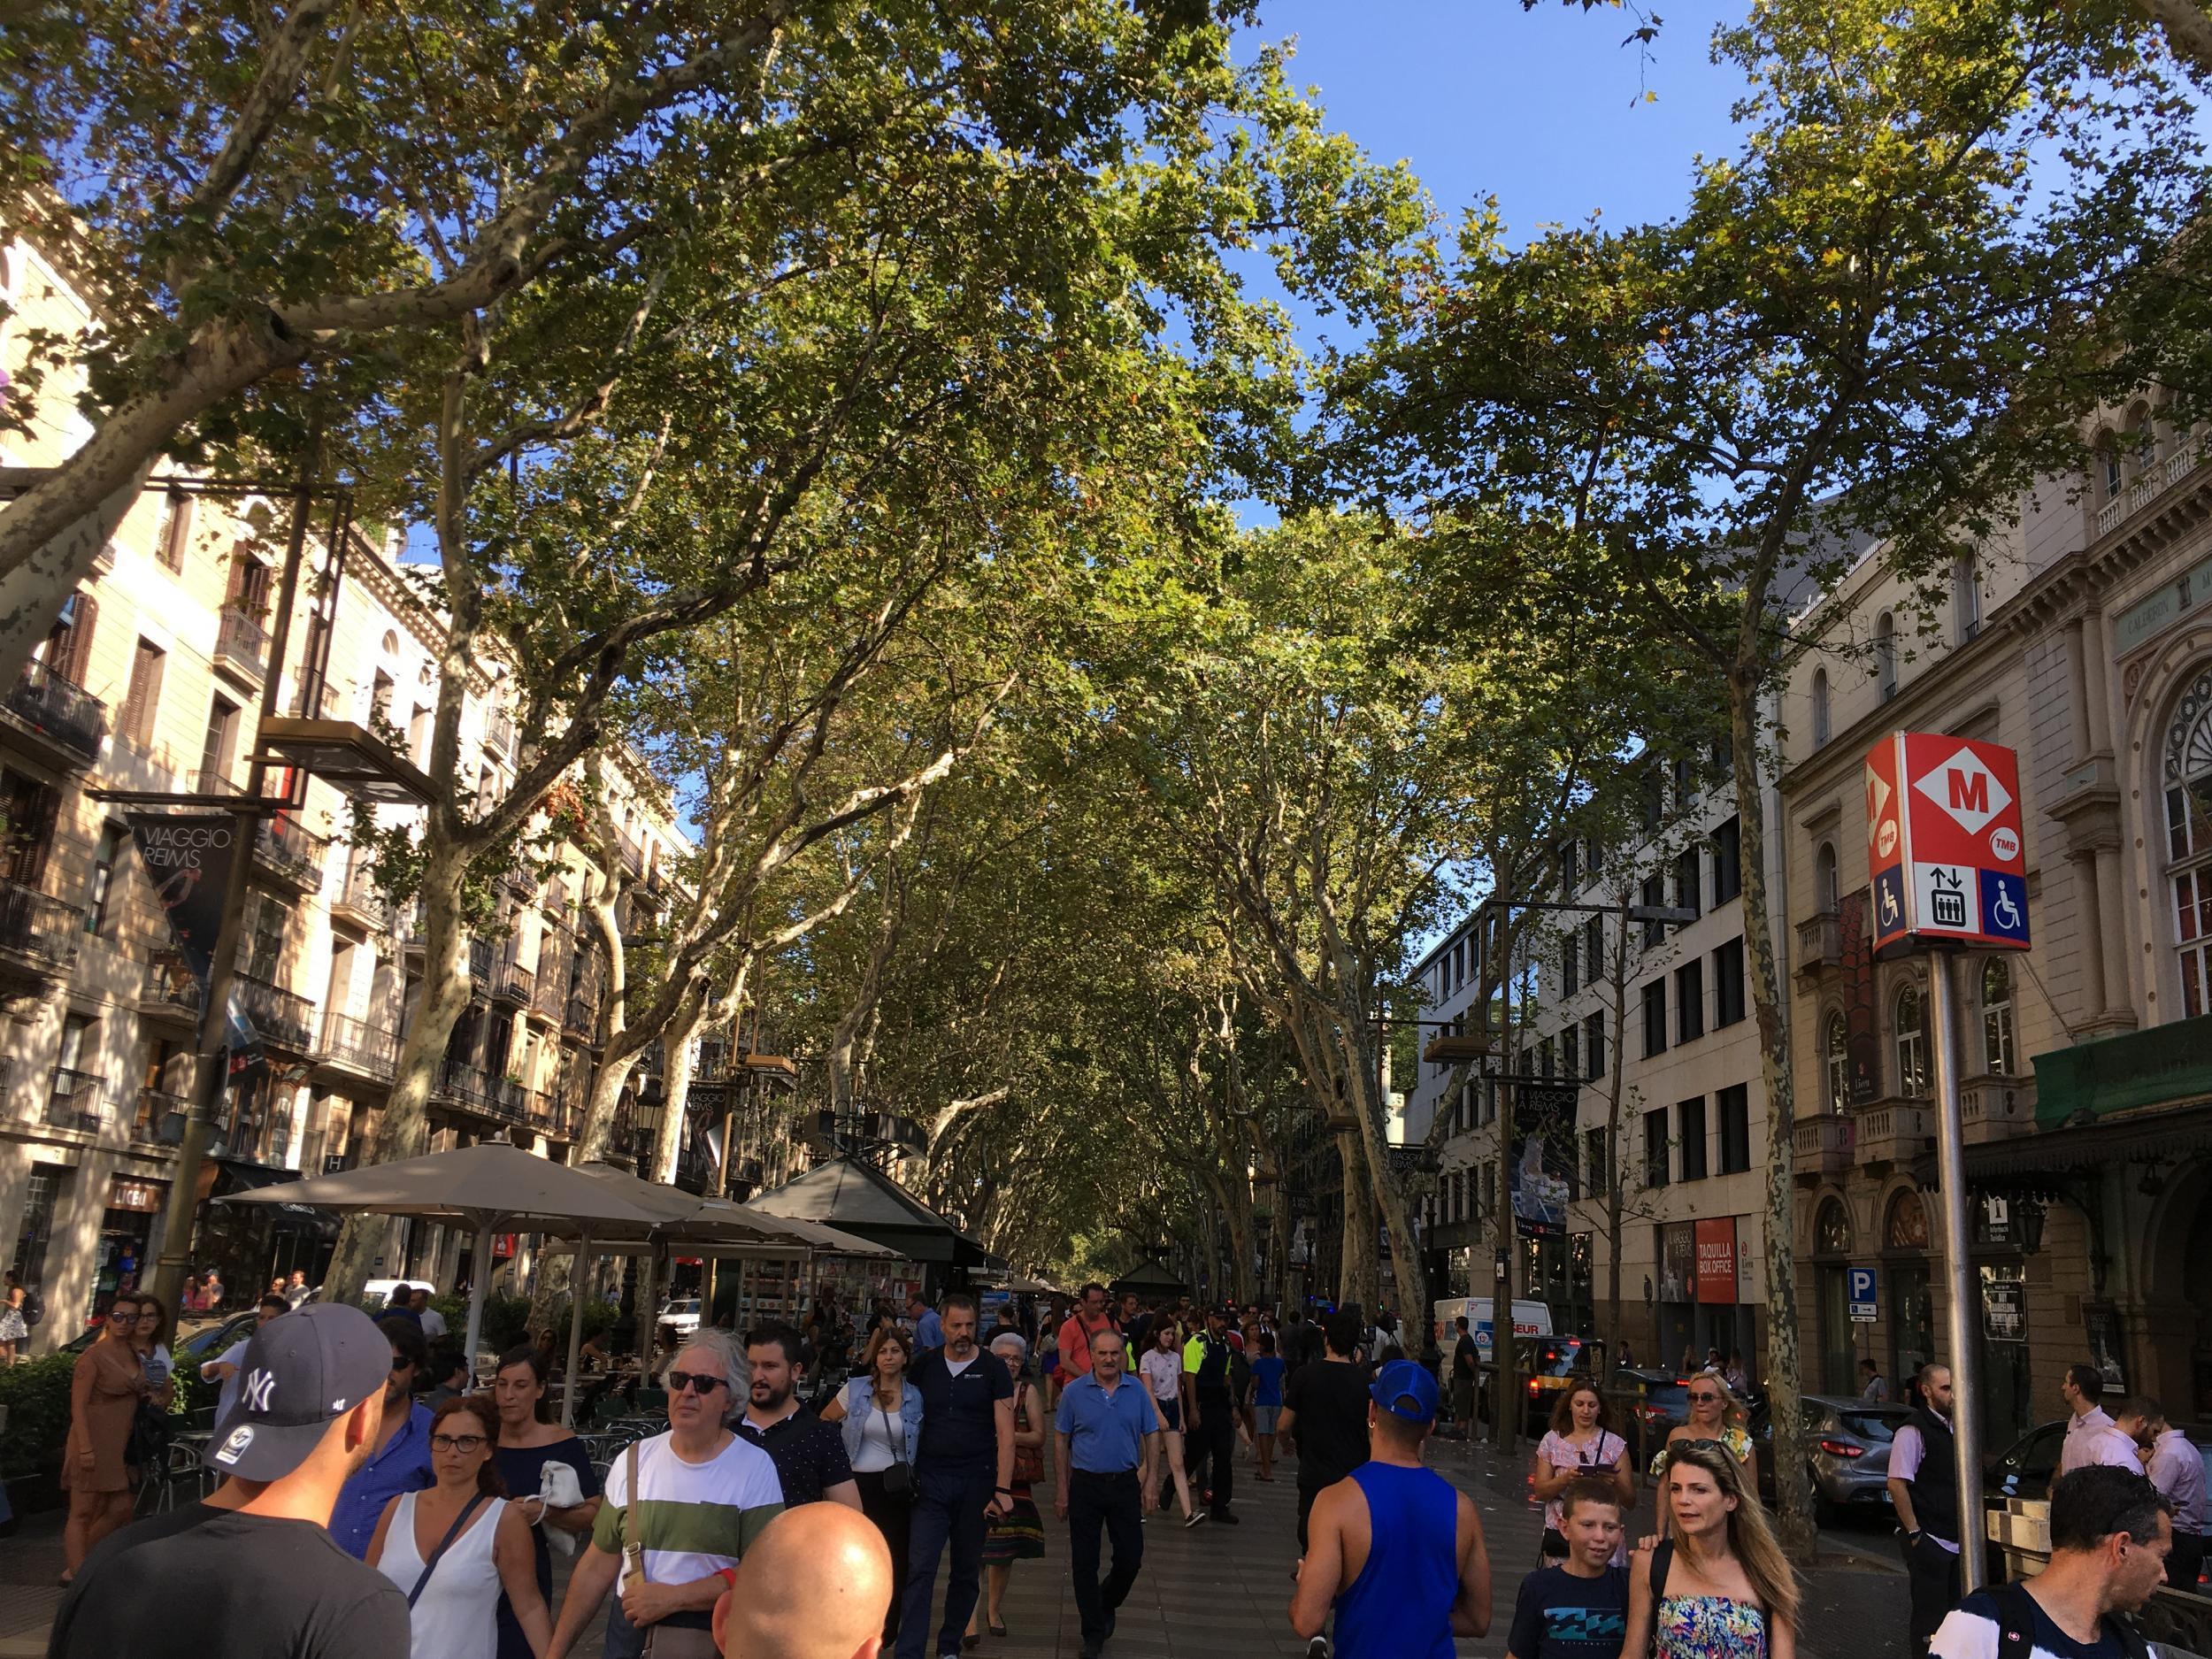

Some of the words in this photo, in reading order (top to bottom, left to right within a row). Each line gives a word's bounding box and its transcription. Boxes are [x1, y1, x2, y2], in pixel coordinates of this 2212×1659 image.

[1947, 767, 1990, 814] M
[144, 826, 231, 849] VIAGGIO
[1880, 831, 1895, 848] TMB
[1995, 837, 2016, 852] TMB
[142, 846, 201, 869] REIMS
[1529, 1089, 1577, 1103] VIAGGIO
[328, 1156, 342, 1171] H
[1699, 1242, 1732, 1258] TAQUILLA
[1699, 1260, 1712, 1274] BOX
[1712, 1259, 1732, 1274] OFFICE
[1853, 1271, 1871, 1299] P
[242, 1367, 276, 1412] NY
